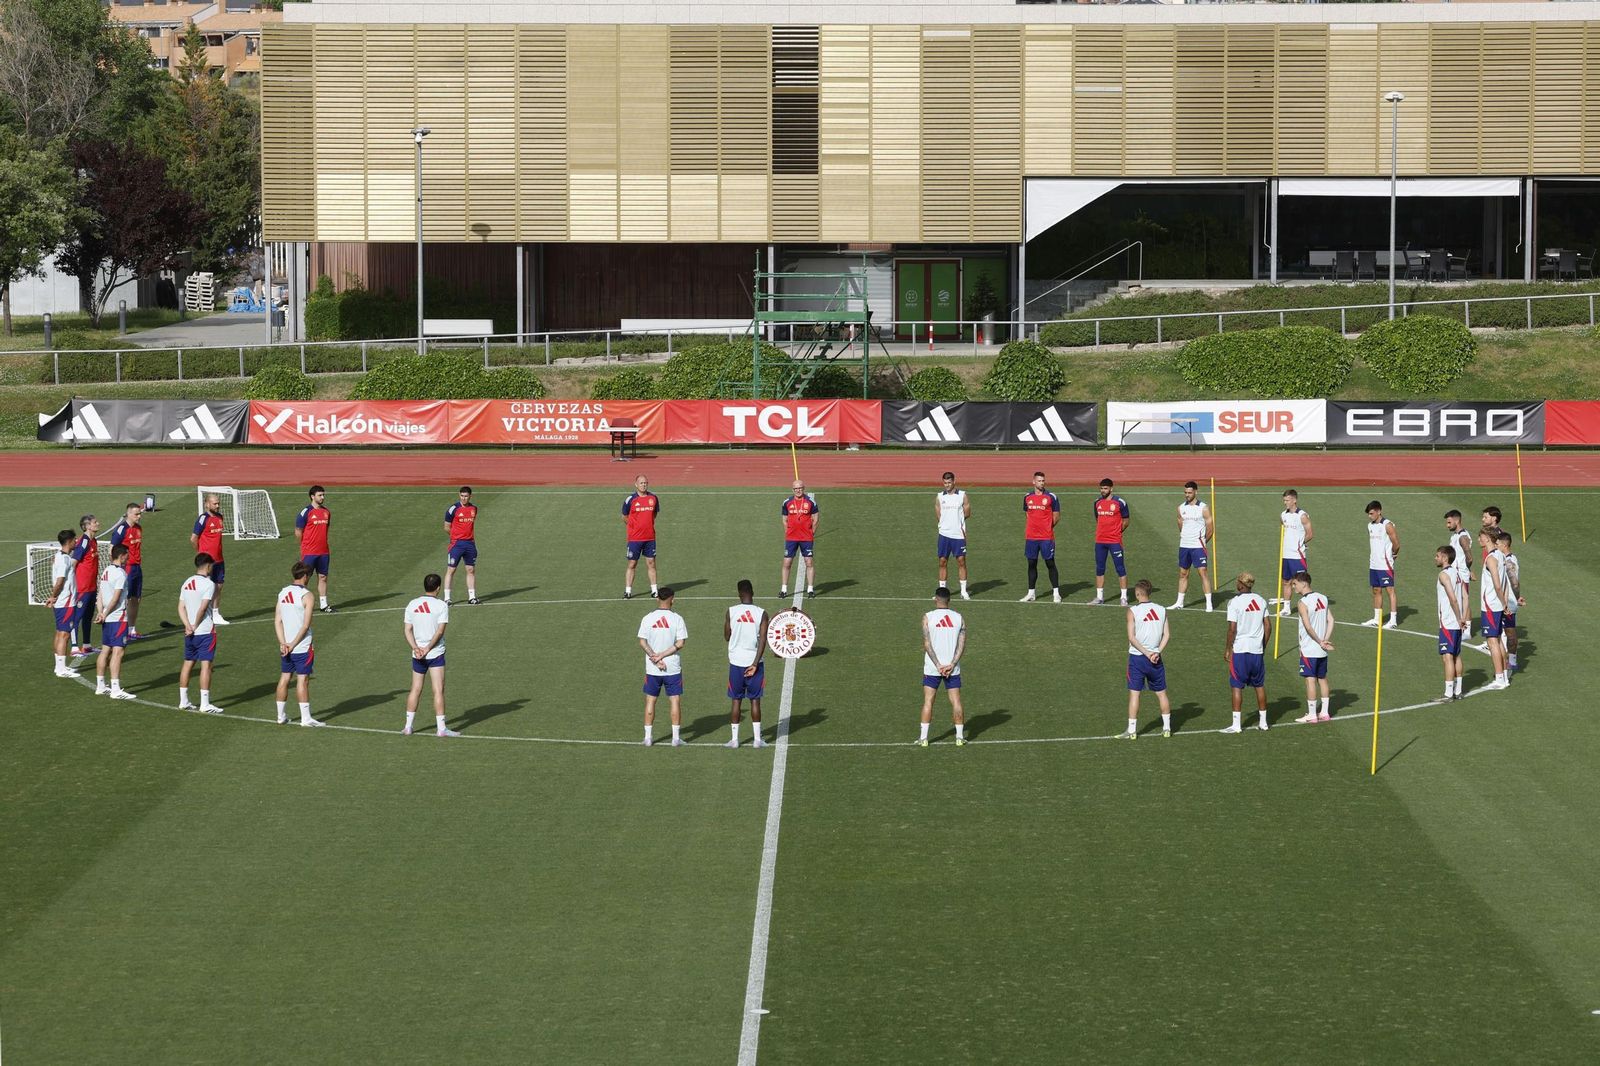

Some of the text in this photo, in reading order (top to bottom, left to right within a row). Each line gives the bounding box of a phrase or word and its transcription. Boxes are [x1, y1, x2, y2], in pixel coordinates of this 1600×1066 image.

[511, 402, 603, 414] CERVEZAS
[297, 412, 426, 435] Halcón viajes
[502, 417, 610, 432] VICTORIA
[722, 406, 825, 437] TCL
[1218, 411, 1294, 433] SEUR
[1347, 409, 1524, 436] EBRO
[772, 640, 810, 655] MANOLO
